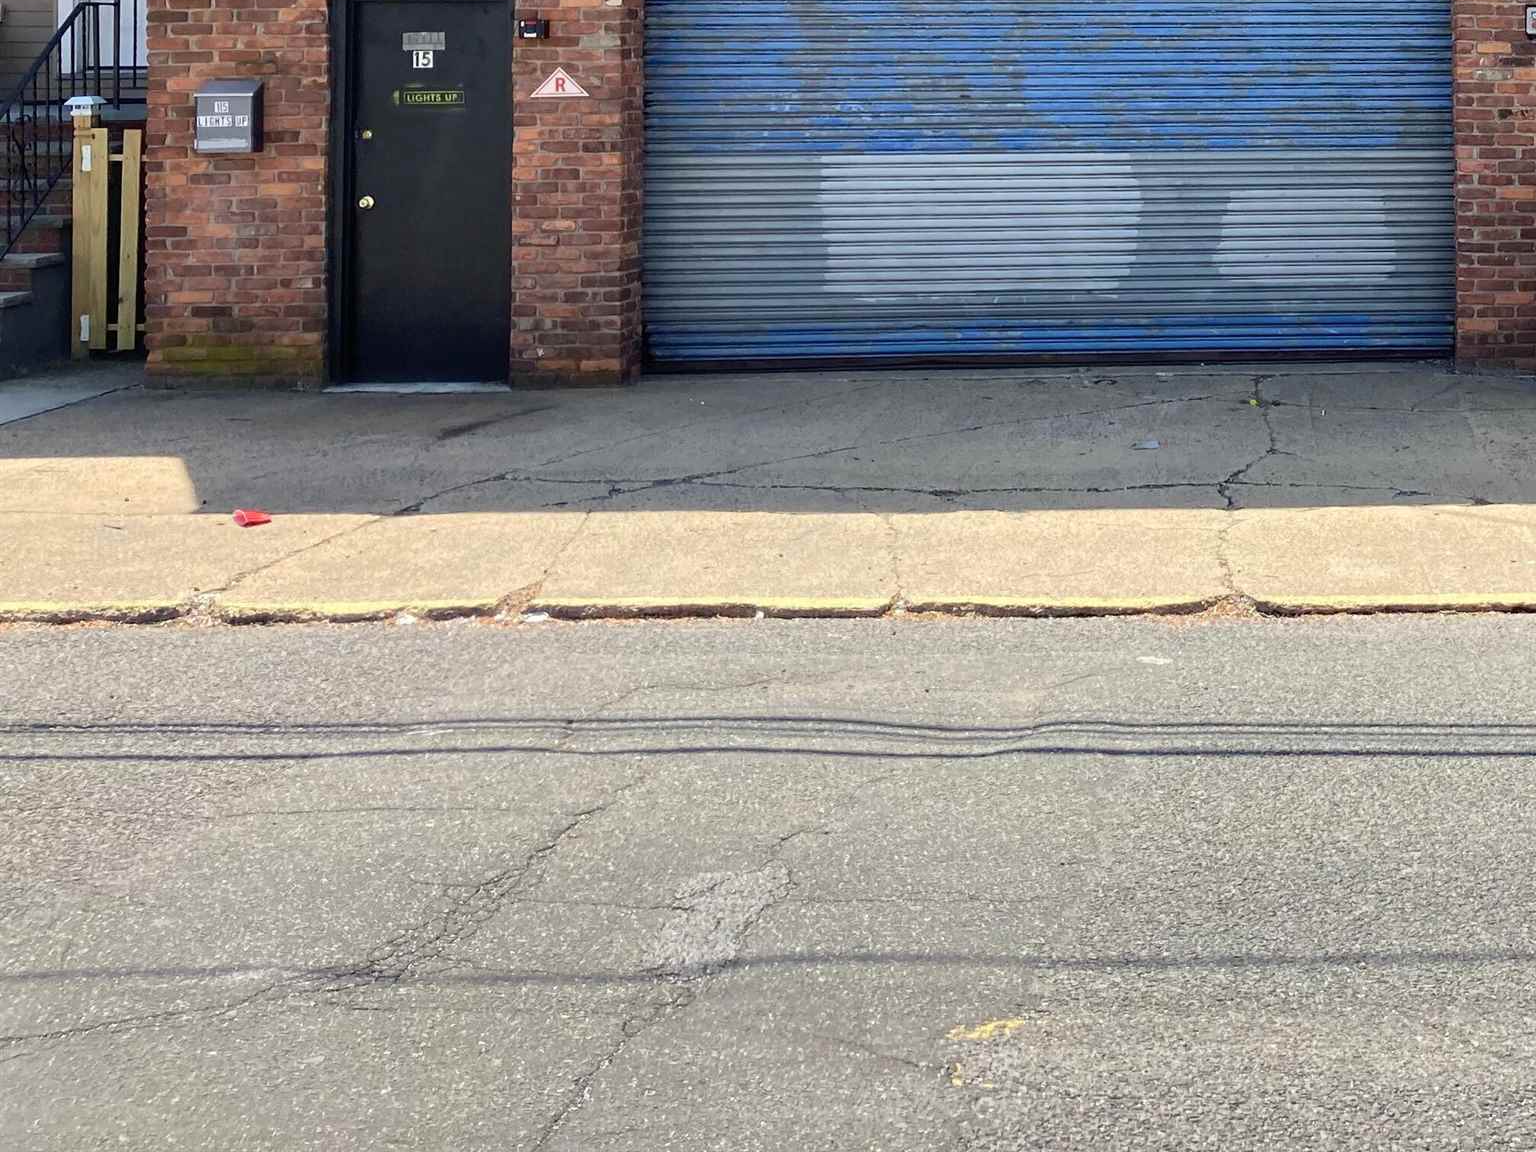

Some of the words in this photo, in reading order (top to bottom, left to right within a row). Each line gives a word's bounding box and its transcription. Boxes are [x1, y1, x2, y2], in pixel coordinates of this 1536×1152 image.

[414, 51, 431, 67] 15
[555, 77, 566, 92] R
[406, 93, 441, 102] LIGHTS
[445, 93, 458, 102] UP
[197, 115, 232, 127] LIGHTS
[235, 115, 248, 126] UP
